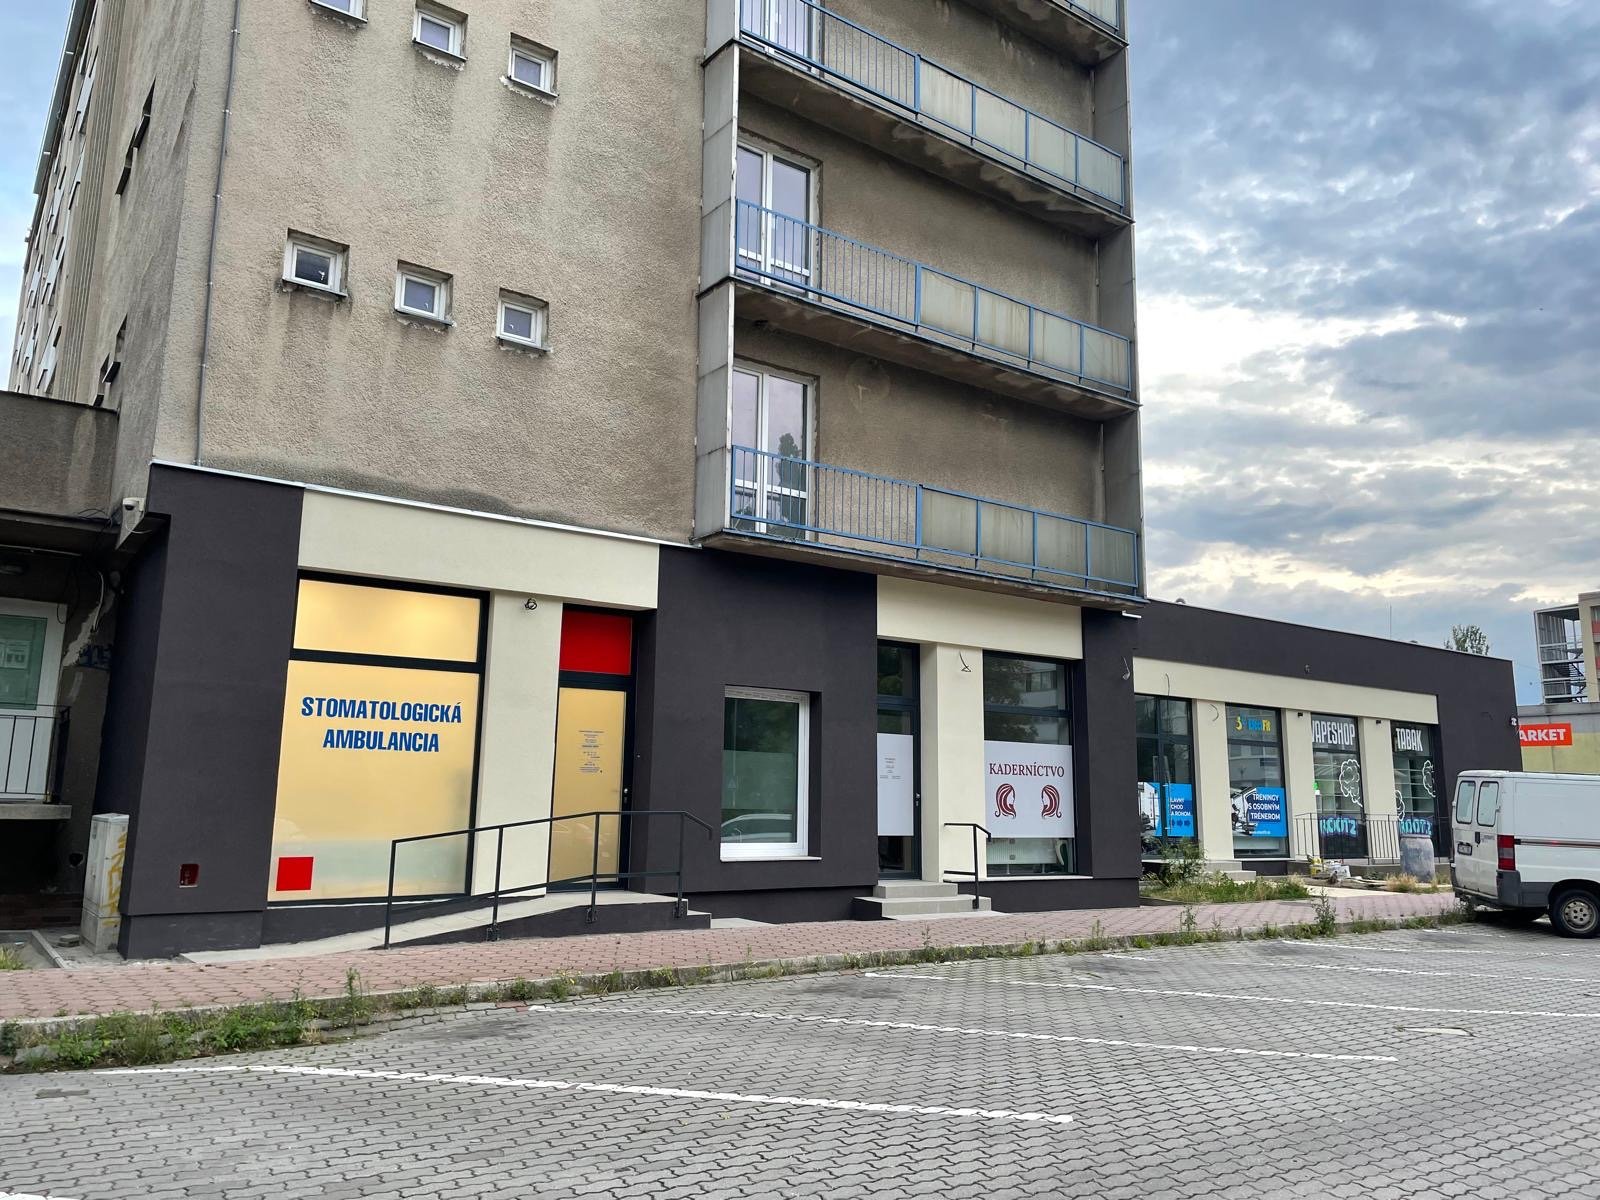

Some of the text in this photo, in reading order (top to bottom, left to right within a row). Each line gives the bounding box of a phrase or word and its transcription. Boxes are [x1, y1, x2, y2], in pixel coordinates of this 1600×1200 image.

[301, 696, 462, 723] STOMATOLOGICKÁ
[322, 729, 440, 752] AMBULANCIA
[1395, 727, 1424, 752] TABAK
[989, 761, 1065, 777] KADERNÍCTVO
[1250, 811, 1281, 821] TRÉNEROM
[1253, 802, 1280, 811] OSOBNÝM
